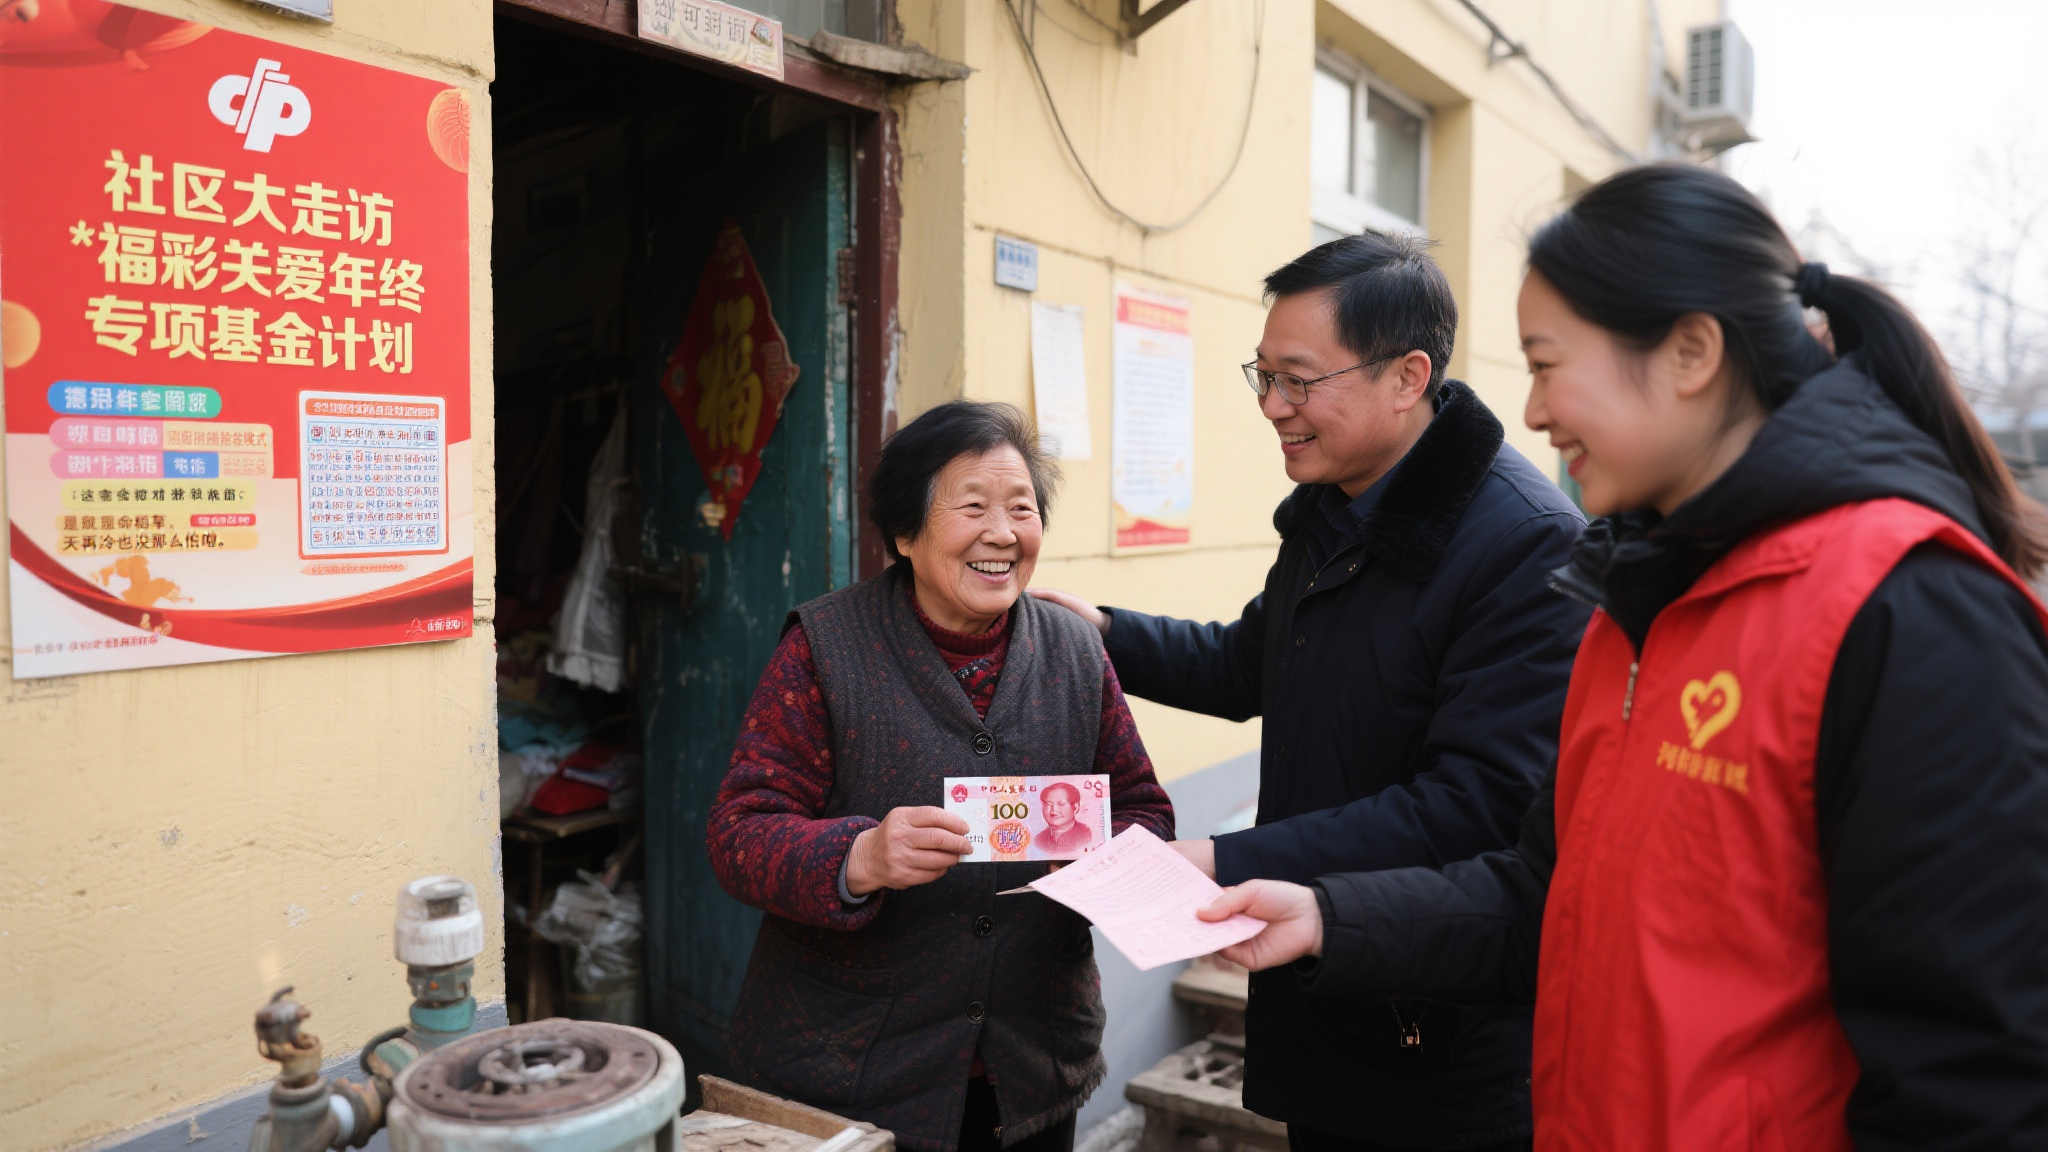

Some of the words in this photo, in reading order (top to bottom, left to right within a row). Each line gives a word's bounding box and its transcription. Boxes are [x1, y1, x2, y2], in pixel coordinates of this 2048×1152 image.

[104, 149, 394, 247] 社区大走访
[85, 295, 413, 374] 专项基金计划
[991, 802, 1029, 820] 100
